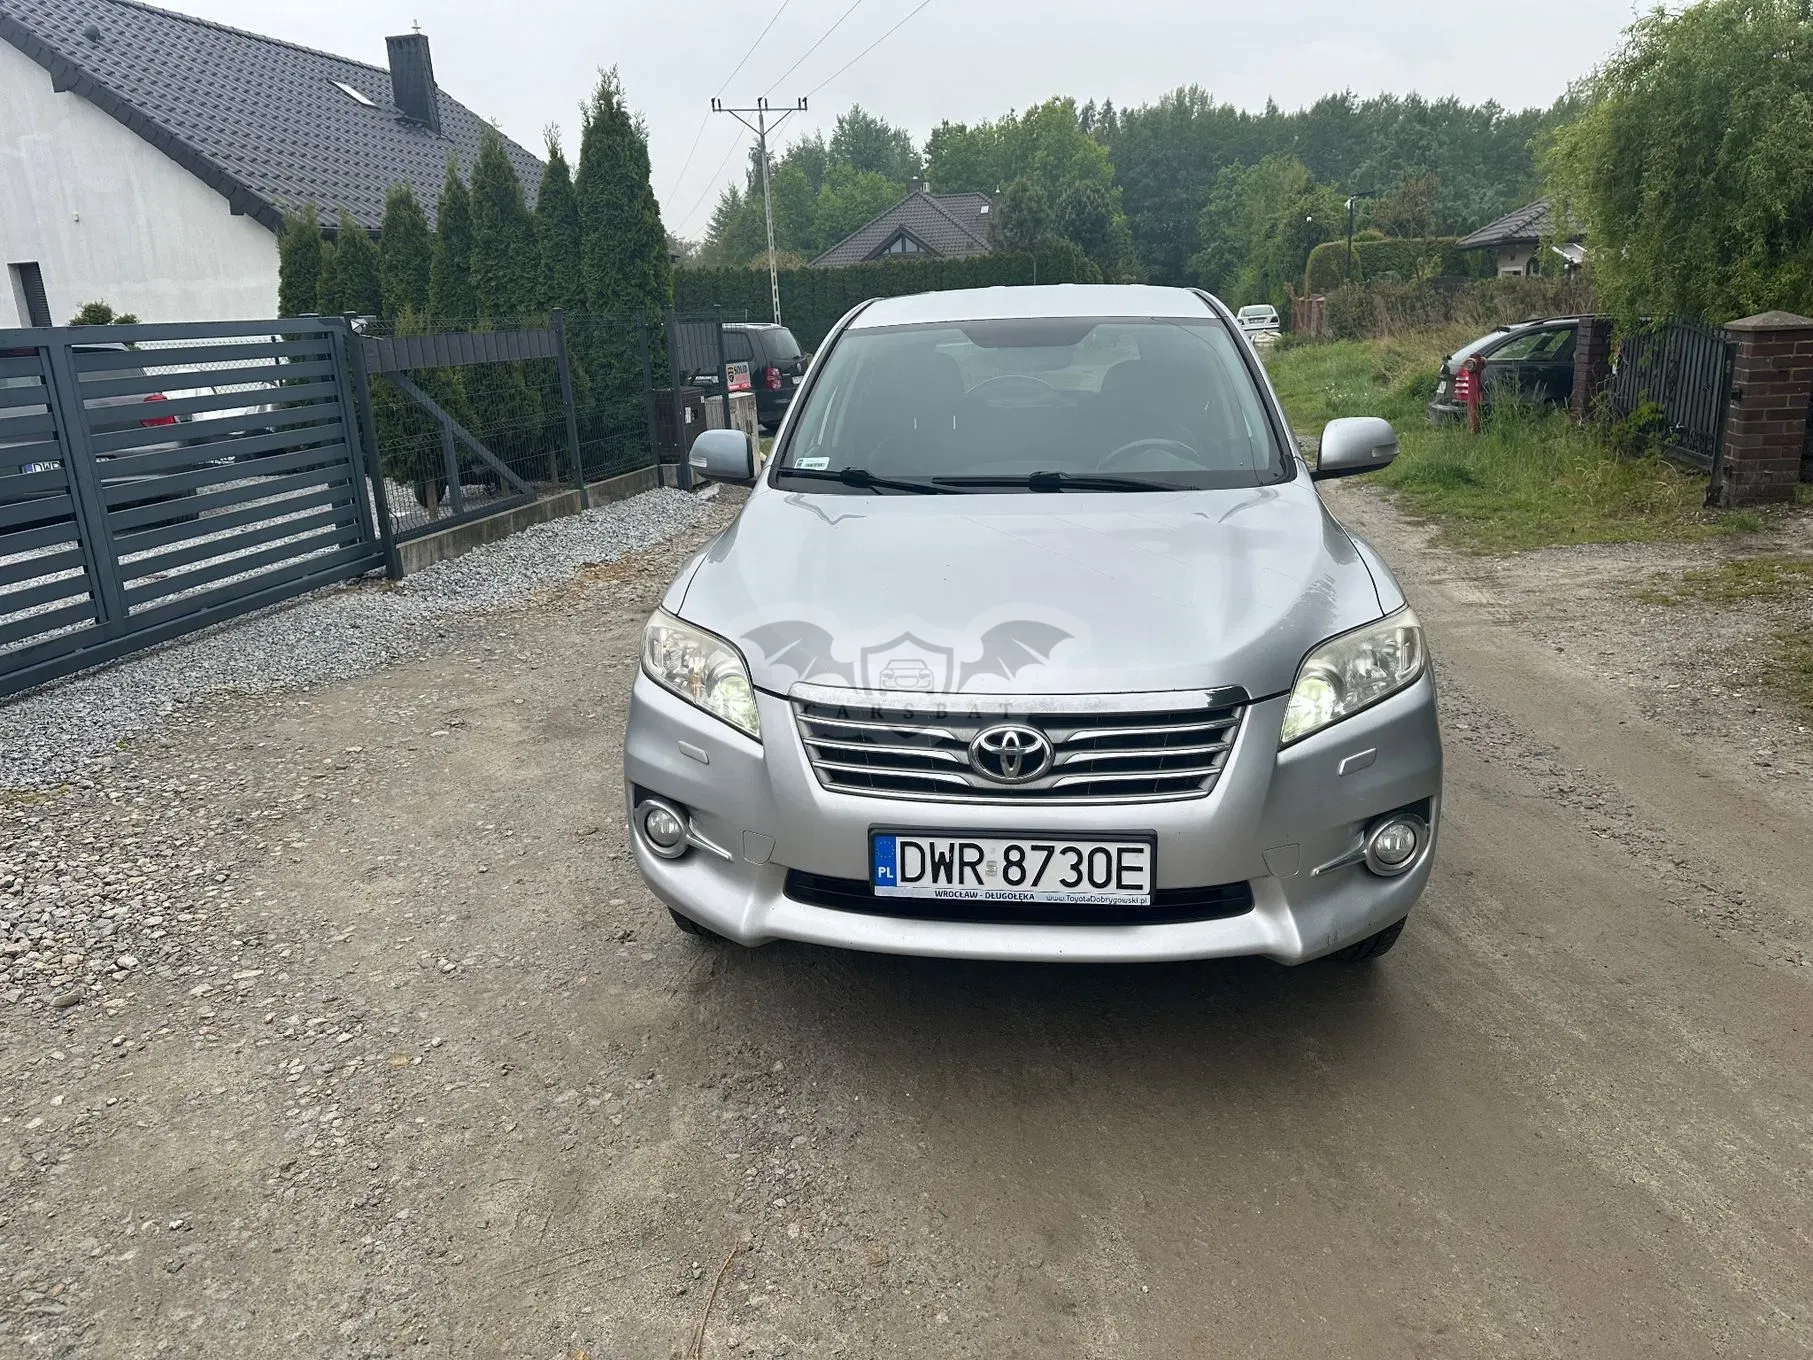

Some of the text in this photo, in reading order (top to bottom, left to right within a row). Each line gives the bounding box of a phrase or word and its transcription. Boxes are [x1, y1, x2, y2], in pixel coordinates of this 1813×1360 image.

[899, 840, 1145, 890] DWR 8730E
[878, 866, 894, 879] PL
[934, 889, 979, 899] WROCŁAW
[984, 891, 1035, 902] DŁUGOŁĘKA
